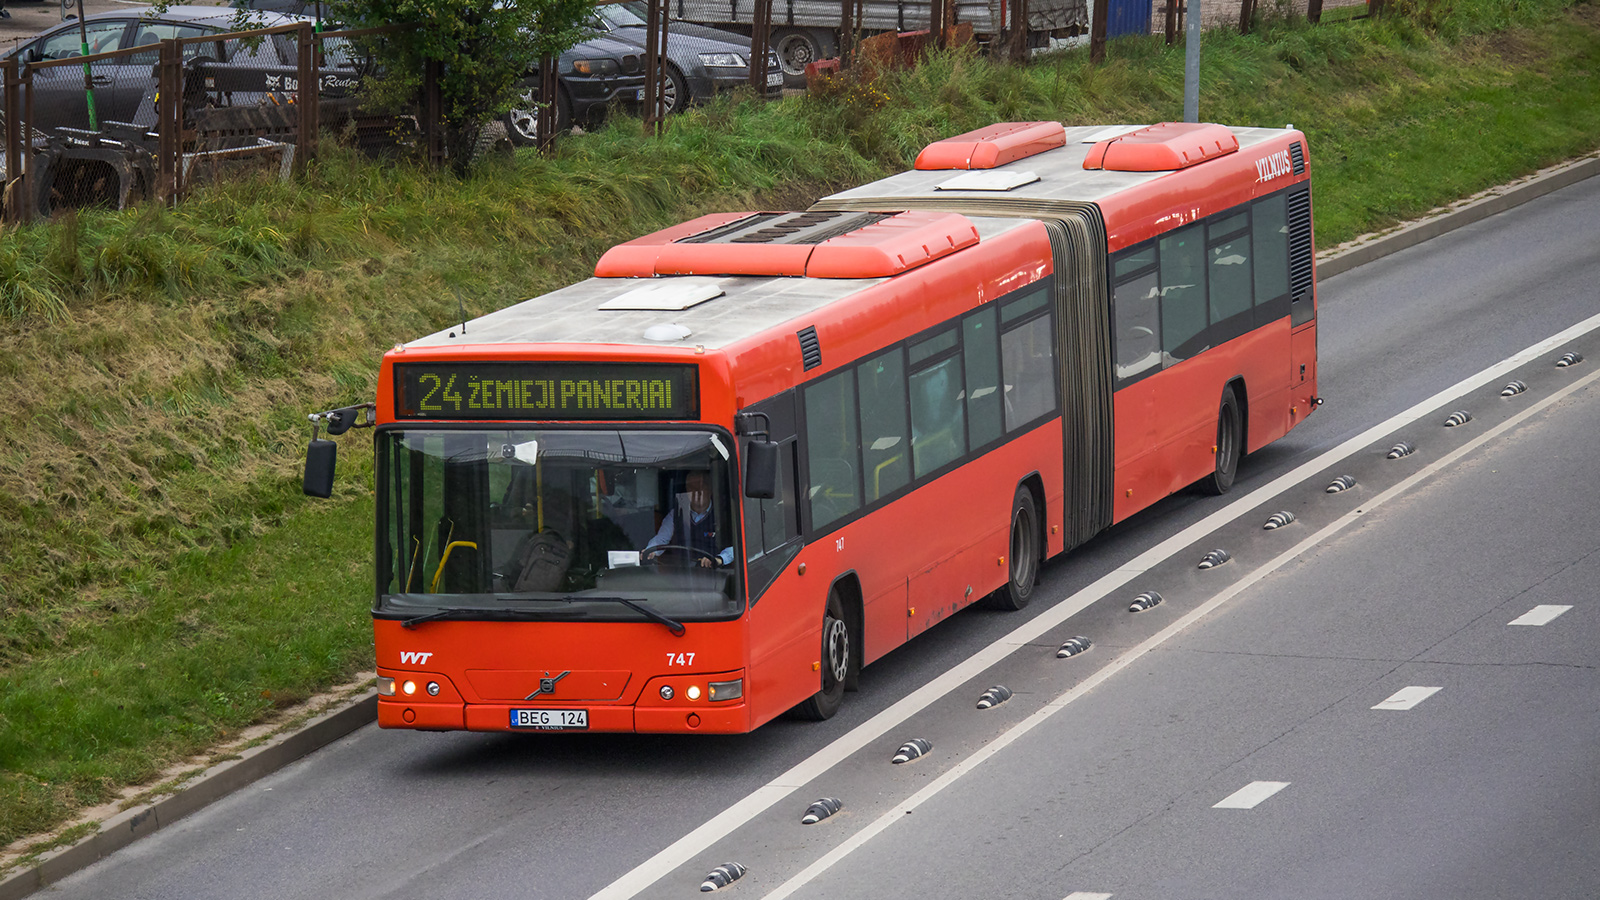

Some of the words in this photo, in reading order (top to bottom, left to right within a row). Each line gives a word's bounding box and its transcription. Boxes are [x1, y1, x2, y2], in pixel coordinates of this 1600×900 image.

[1255, 149, 1291, 183] VILNIUS
[419, 373, 462, 411] 24
[468, 375, 555, 409] ŽEMIEJI
[560, 380, 672, 410] PANERIAI
[835, 536, 845, 553] 747
[666, 652, 696, 666] 747
[520, 712, 550, 725] BEG
[560, 712, 585, 725] 124
